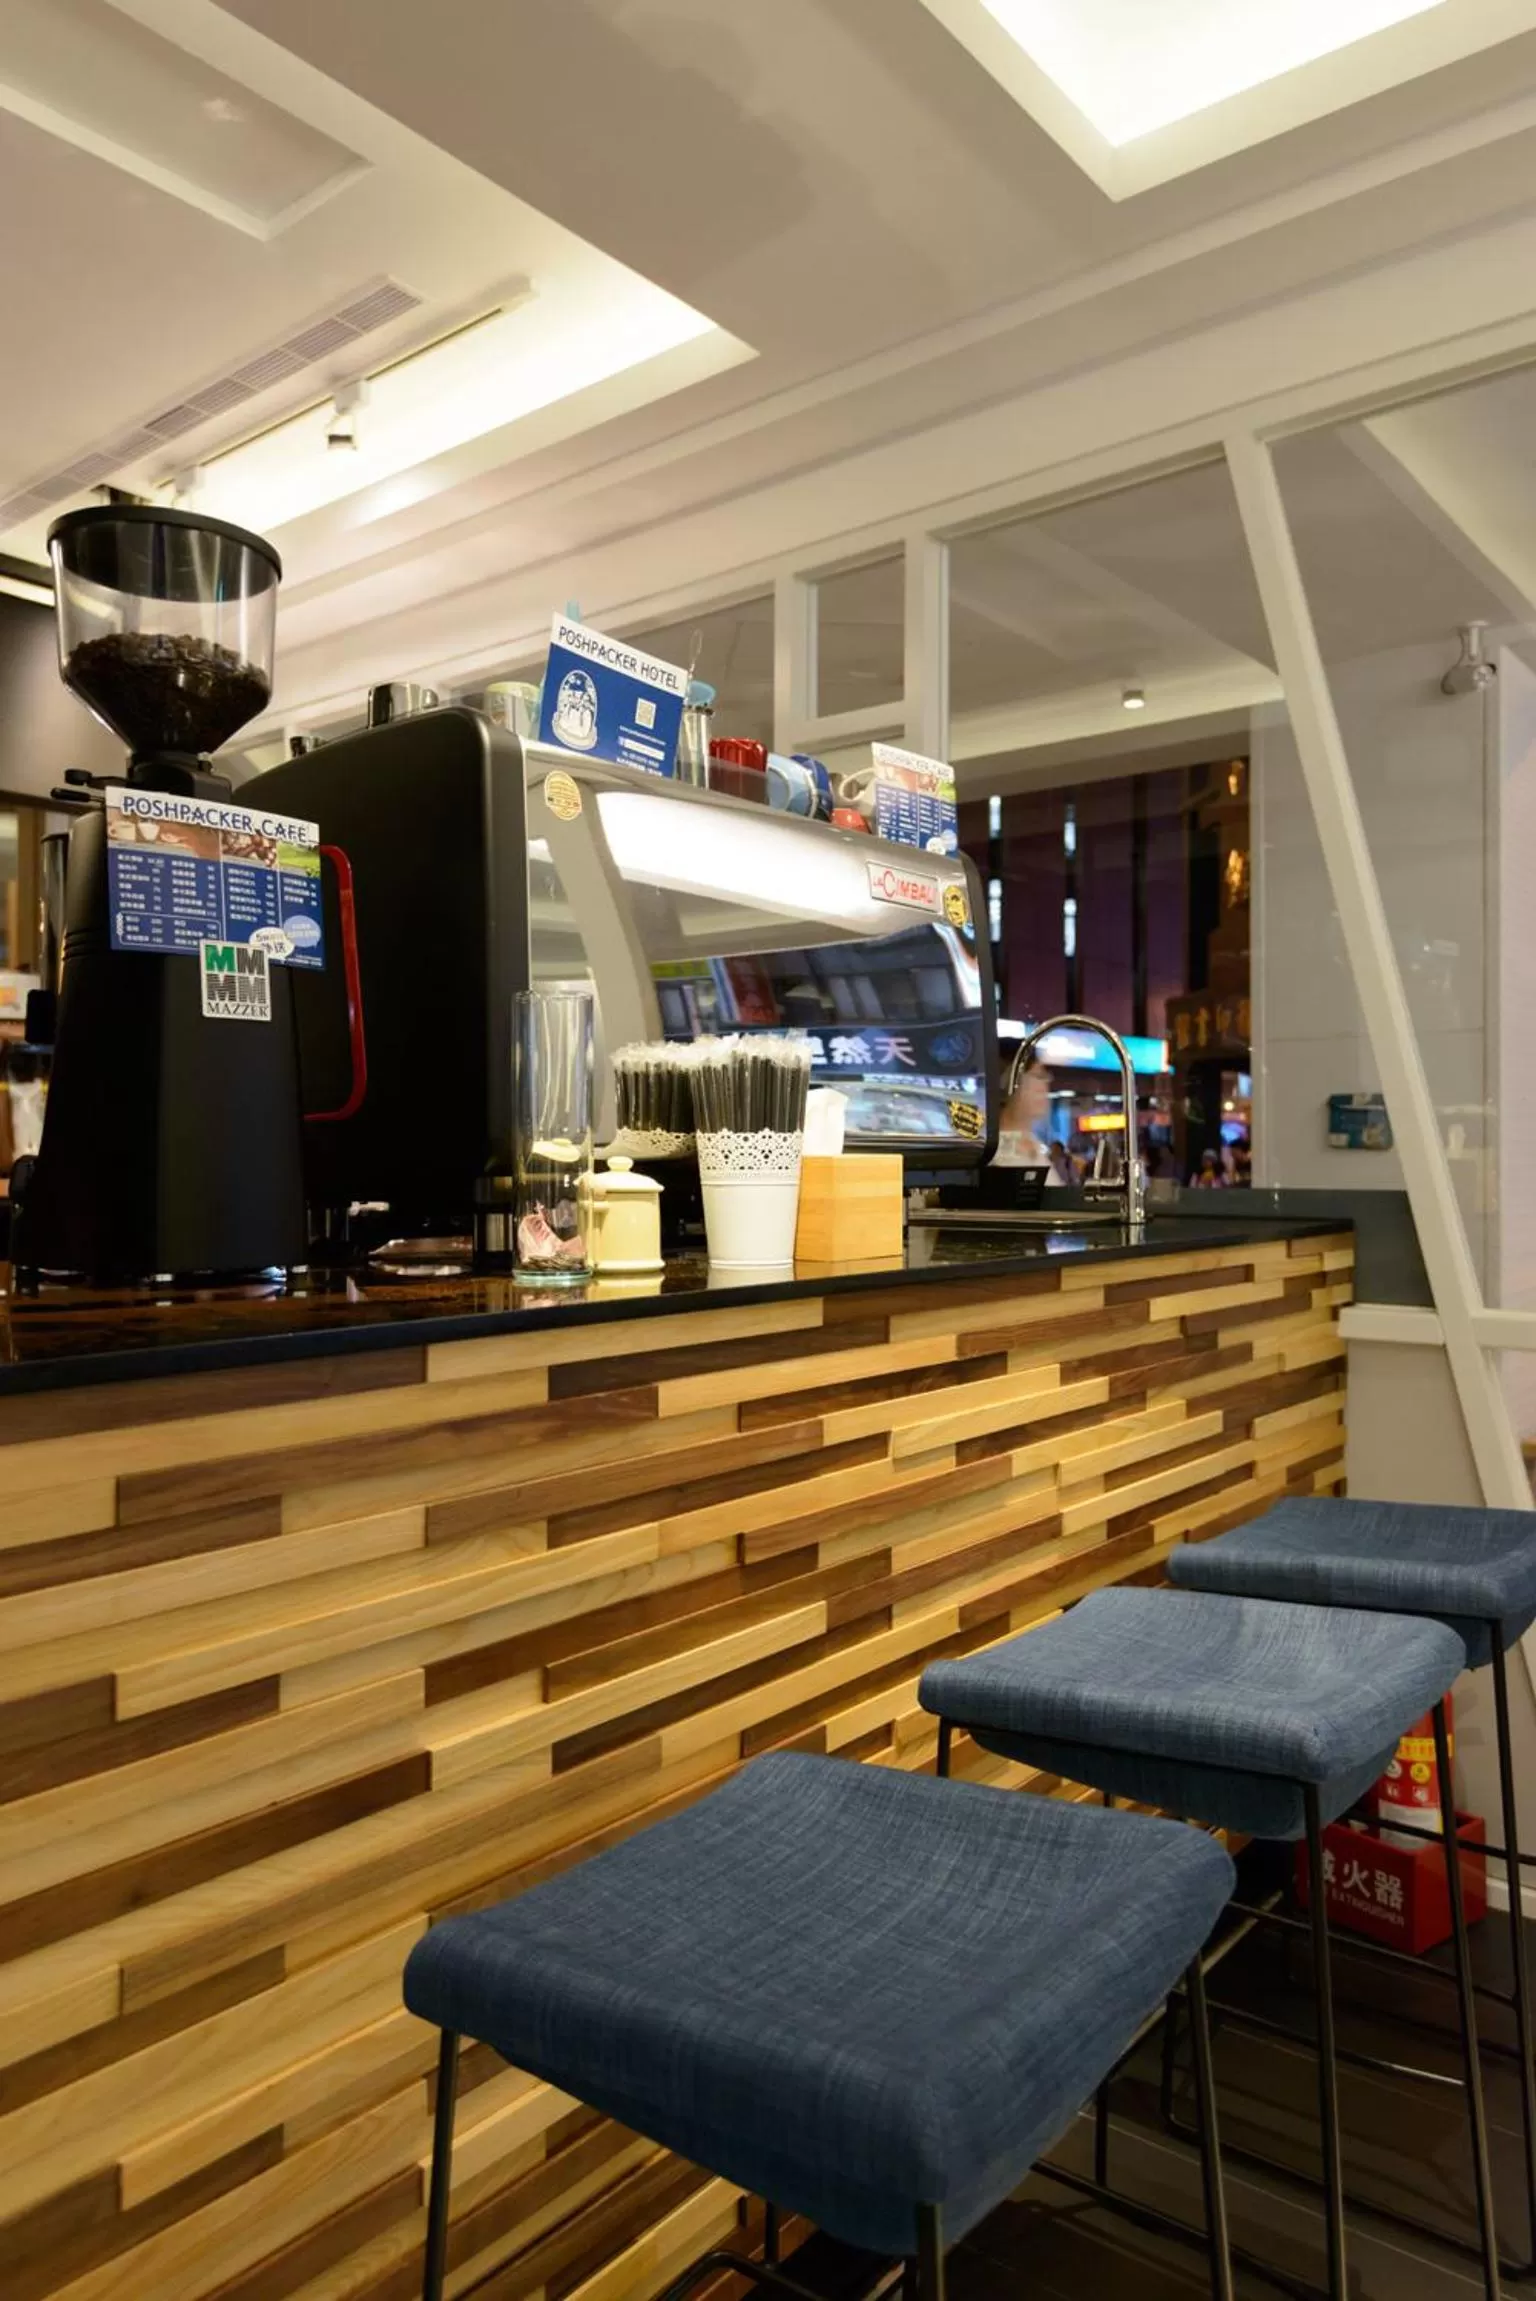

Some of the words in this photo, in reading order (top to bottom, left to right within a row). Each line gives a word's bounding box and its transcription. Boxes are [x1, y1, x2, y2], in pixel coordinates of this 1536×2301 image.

[558, 625, 637, 673] POSHPACKER
[641, 662, 679, 690] HOTEL
[122, 795, 252, 833] POSHPACKER
[261, 818, 306, 843] CAFE
[206, 1002, 269, 1018] MAZZER
